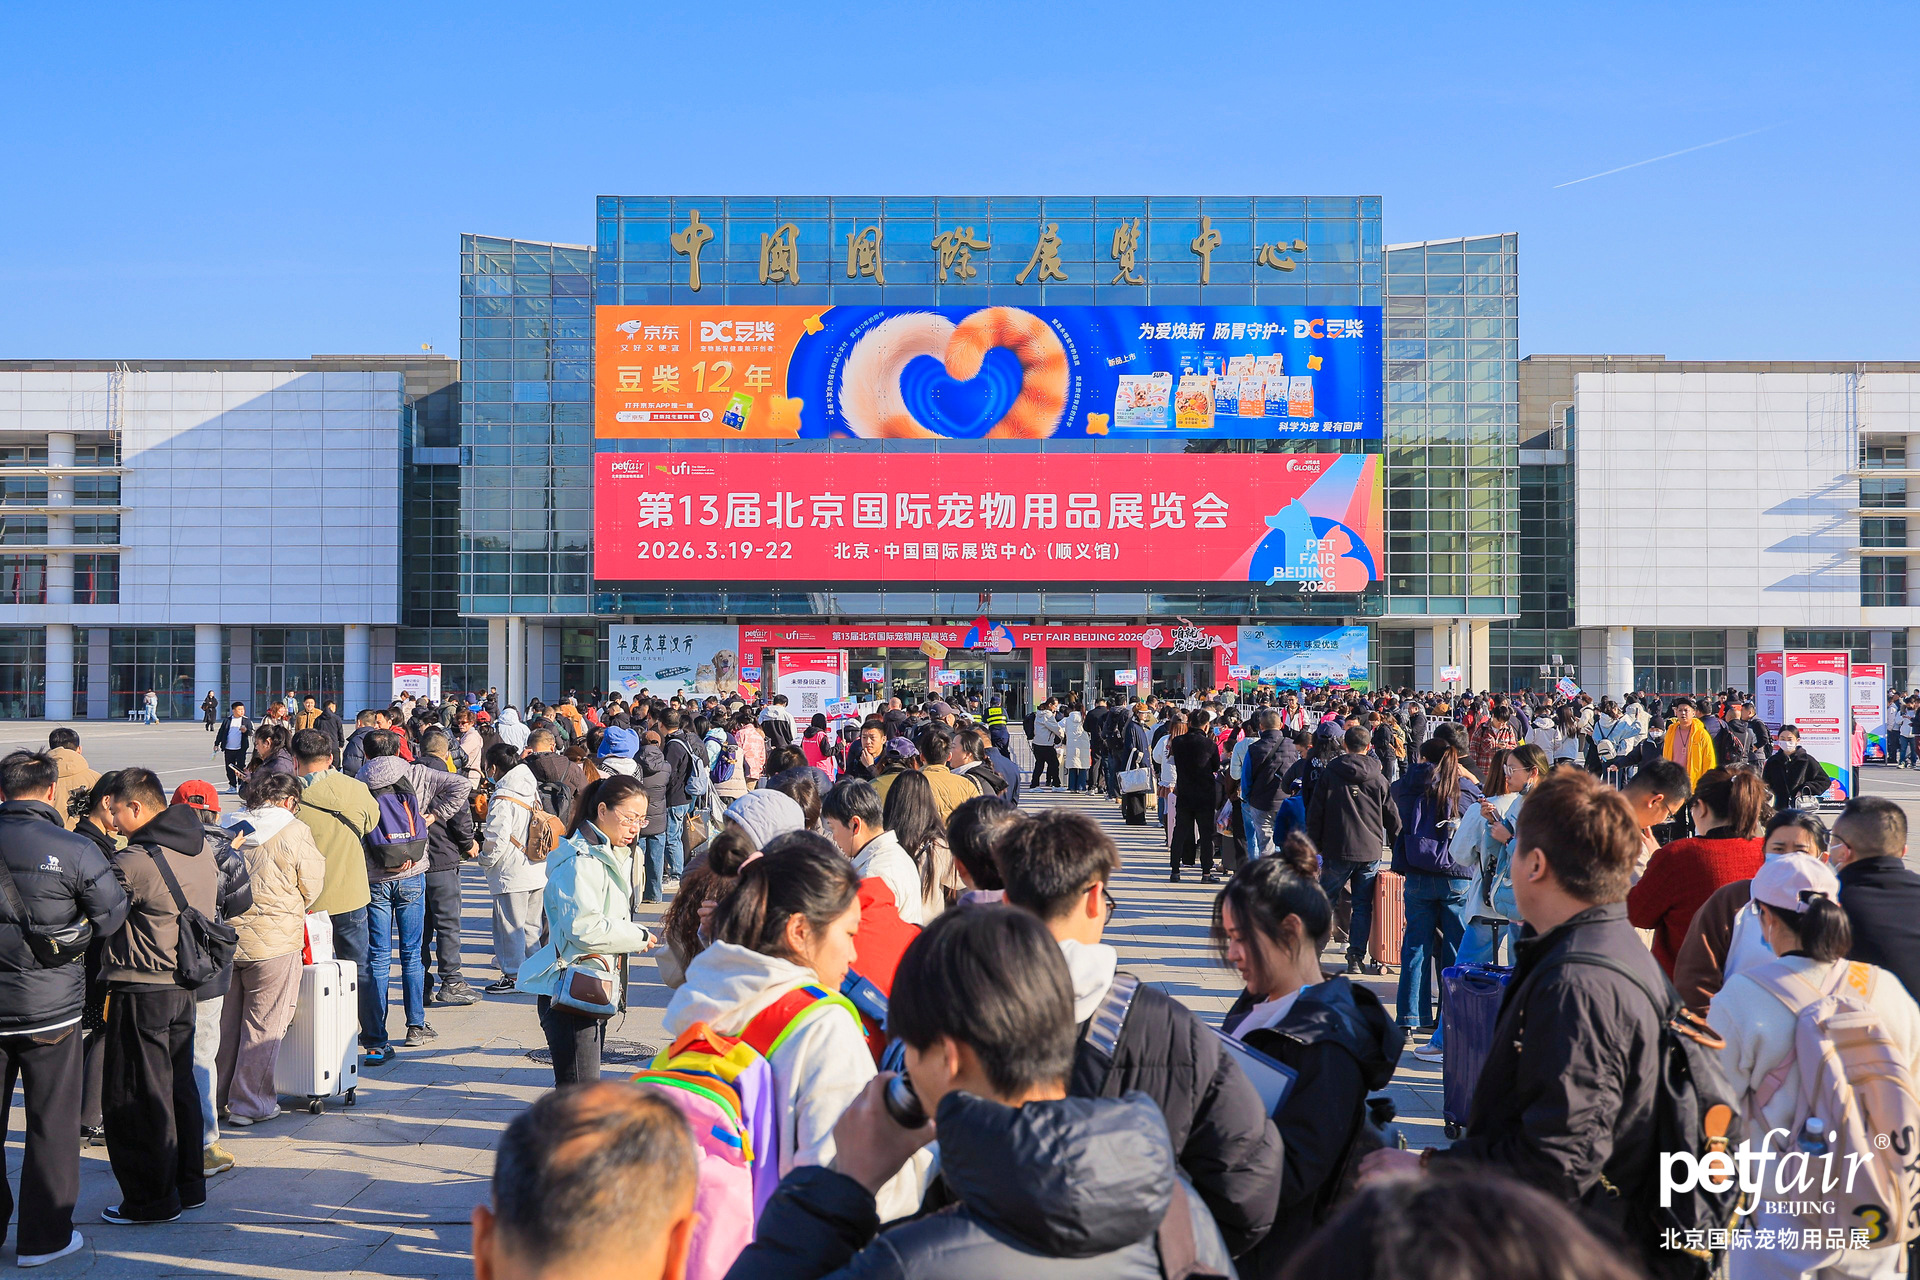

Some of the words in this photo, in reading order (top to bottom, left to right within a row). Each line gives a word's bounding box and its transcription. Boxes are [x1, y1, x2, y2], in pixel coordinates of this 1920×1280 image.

[644, 326, 679, 340] 京东
[1138, 322, 1205, 340] 为爱焕新
[1213, 322, 1288, 340] 肠胃守护+
[1278, 421, 1319, 432] 科学为宠
[1322, 421, 1363, 432] 爱有回声
[637, 492, 1229, 530] 第13届北京国际宠物用品展览会
[637, 541, 792, 559] 2026.3.19-22
[1306, 539, 1336, 550] PET
[1300, 553, 1336, 564] FAIR
[1274, 567, 1336, 578] BEIJING
[1299, 581, 1336, 592] 2026
[832, 632, 957, 641] 第13届北京国际宠物用品展览会
[1022, 633, 1043, 641] PET
[1046, 633, 1070, 641] FAIR
[1073, 633, 1115, 641] BEIJING
[1118, 633, 1143, 641] 2026
[1267, 640, 1301, 649] 长久陪伴
[1304, 640, 1339, 649] 味爱优选
[40, 864, 63, 872] CAMEL
